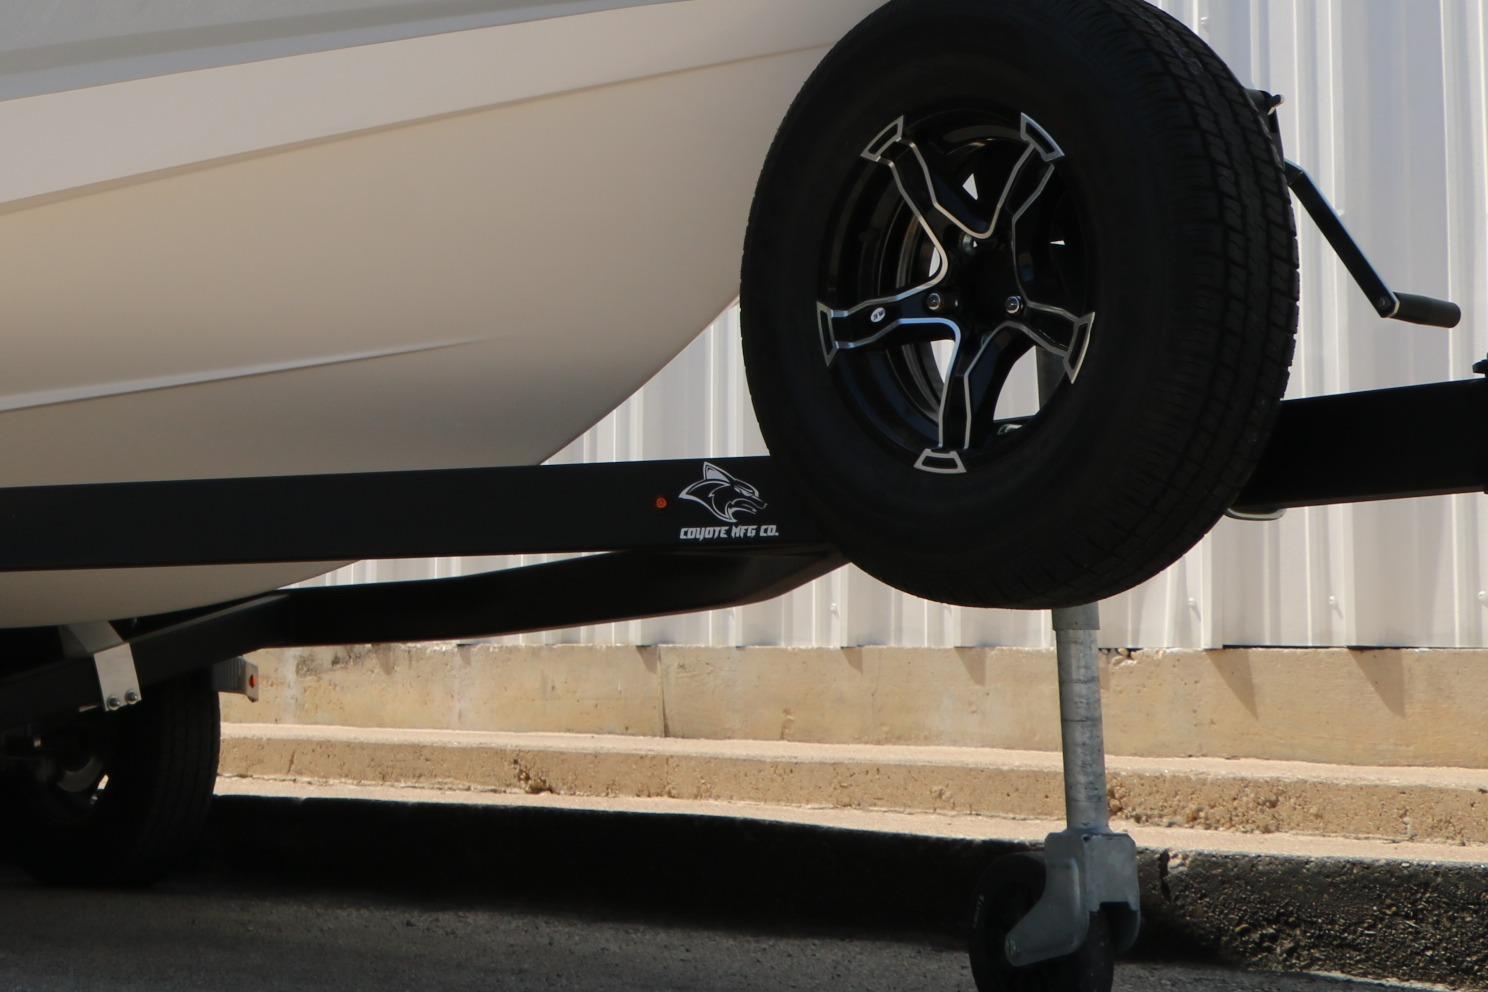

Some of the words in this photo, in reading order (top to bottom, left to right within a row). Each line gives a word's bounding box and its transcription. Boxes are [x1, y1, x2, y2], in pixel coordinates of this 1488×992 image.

[679, 526, 728, 541] COYOTE
[731, 525, 758, 539] MFG
[759, 524, 779, 537] CO.
